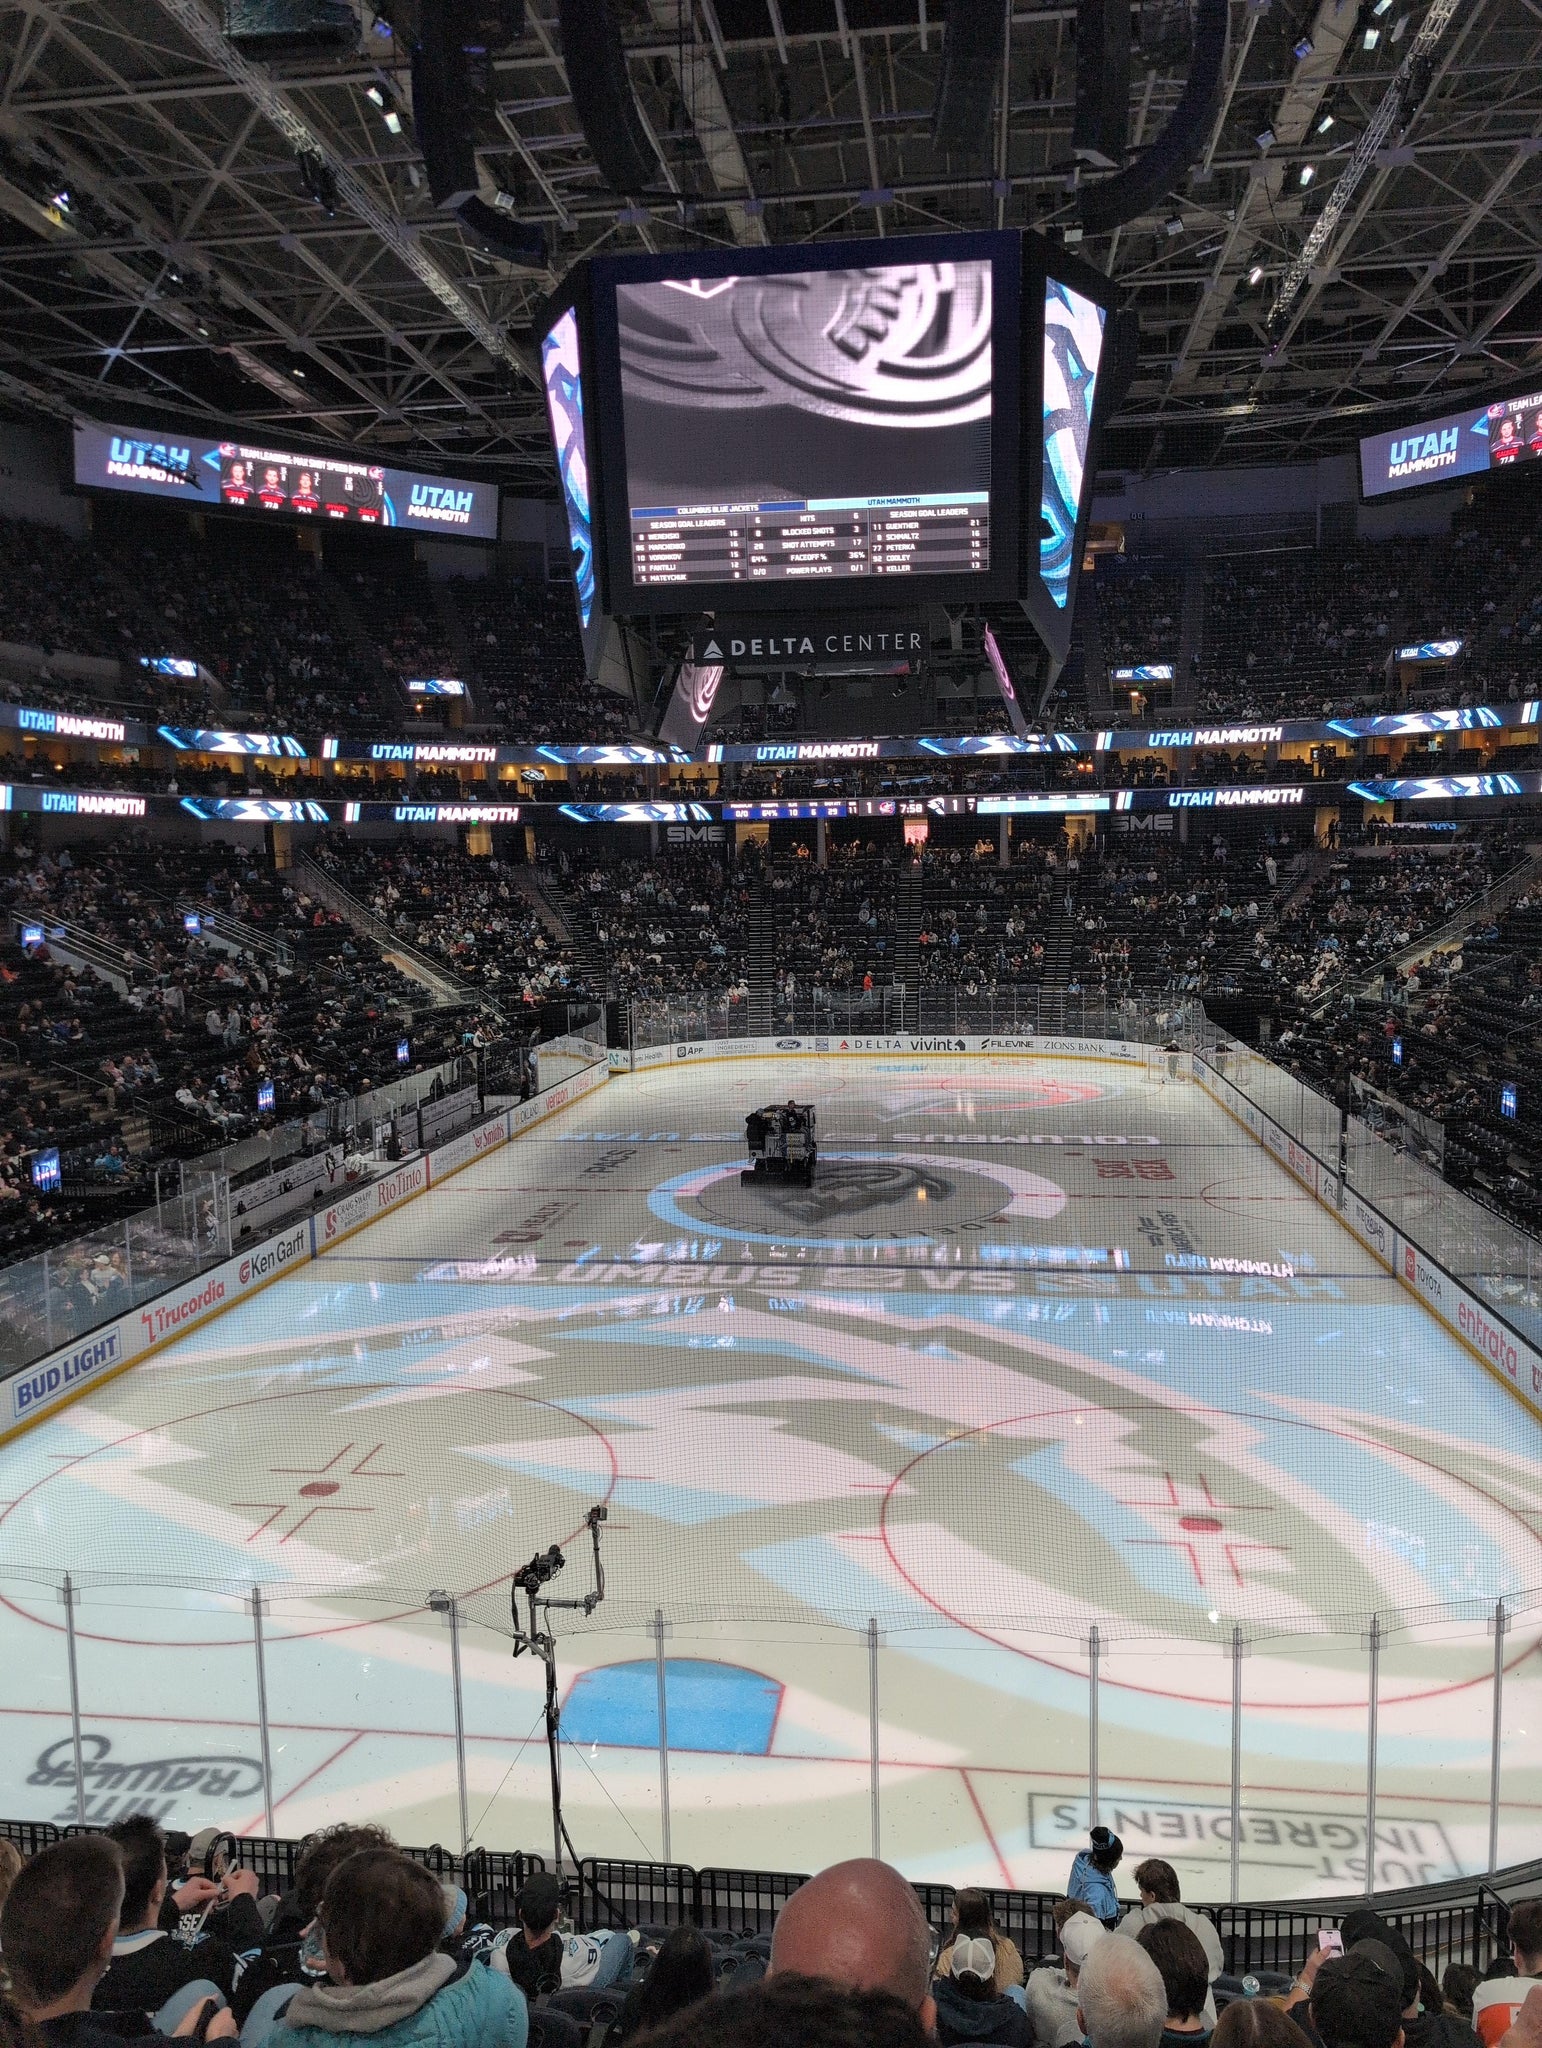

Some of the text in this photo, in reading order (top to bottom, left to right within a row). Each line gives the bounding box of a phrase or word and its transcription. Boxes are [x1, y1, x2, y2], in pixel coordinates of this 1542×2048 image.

[1508, 398, 1528, 412] TEAM
[1390, 426, 1459, 465] UTAH
[1388, 450, 1457, 478] MAMMOTH
[411, 484, 473, 512] UTAH
[868, 497, 920, 506] UTAH MAMMOTH
[408, 504, 469, 523] MAMMOTH
[678, 504, 759, 515] COLUMBUS BLUE JACKETS
[890, 508, 968, 519] SEASON GOAL LEADERS
[651, 519, 726, 529] SEASON GOAL LEADERS
[782, 528, 812, 536] BLOCKED
[812, 527, 834, 535] SHOTS
[886, 522, 919, 530] GUENTHER
[782, 541, 800, 549] SHOT
[800, 540, 835, 548] ATTEMPTS
[886, 543, 915, 551] PETERKA
[791, 554, 820, 562] FACEOFF
[731, 633, 921, 656] DELTA CENTER
[19, 709, 125, 740] UTAH MAMMOTH
[1148, 726, 1282, 746] UTAH MAMMOTH
[372, 744, 496, 761] UTAH MAMMOTH
[757, 743, 879, 760] UTAH MAMMOTH
[42, 792, 145, 815] UTAH MAMMOTH
[952, 800, 958, 811] 1
[1168, 788, 1303, 807] UTAH MAMMOTH
[395, 806, 519, 822] UTAH MAMMOTH
[736, 810, 748, 818] 0/0
[849, 806, 857, 814] 11
[866, 802, 872, 814] 1
[900, 804, 923, 813] 7:58
[969, 803, 974, 811] 7
[1111, 814, 1173, 831] SME
[667, 826, 726, 842] SME
[855, 1039, 901, 1050] DELTA
[910, 1037, 952, 1051] vivint
[991, 1040, 1034, 1048] FILEVINE
[1043, 1041, 1105, 1053] ZIONS BANK
[545, 1088, 568, 1110] verizon
[483, 1124, 505, 1147] Smith's
[892, 1134, 1160, 1145] COLUMBUS
[377, 1169, 422, 1207] Rio Tinto
[519, 1201, 568, 1228] HEALTH
[855, 1223, 986, 1240] DELTA
[250, 1229, 304, 1279] Ken Garff
[1138, 1275, 1345, 1298] UTAH
[1417, 1264, 1441, 1299] TOYOTA
[155, 1279, 225, 1332] Trucordia
[1458, 1302, 1517, 1378] entrata
[18, 1334, 117, 1409] BUD LIGHT
[26, 1733, 273, 1799] CRAWLER
[1053, 1804, 1425, 1855] INGREDIENS
[1318, 1856, 1440, 1885] JUST
